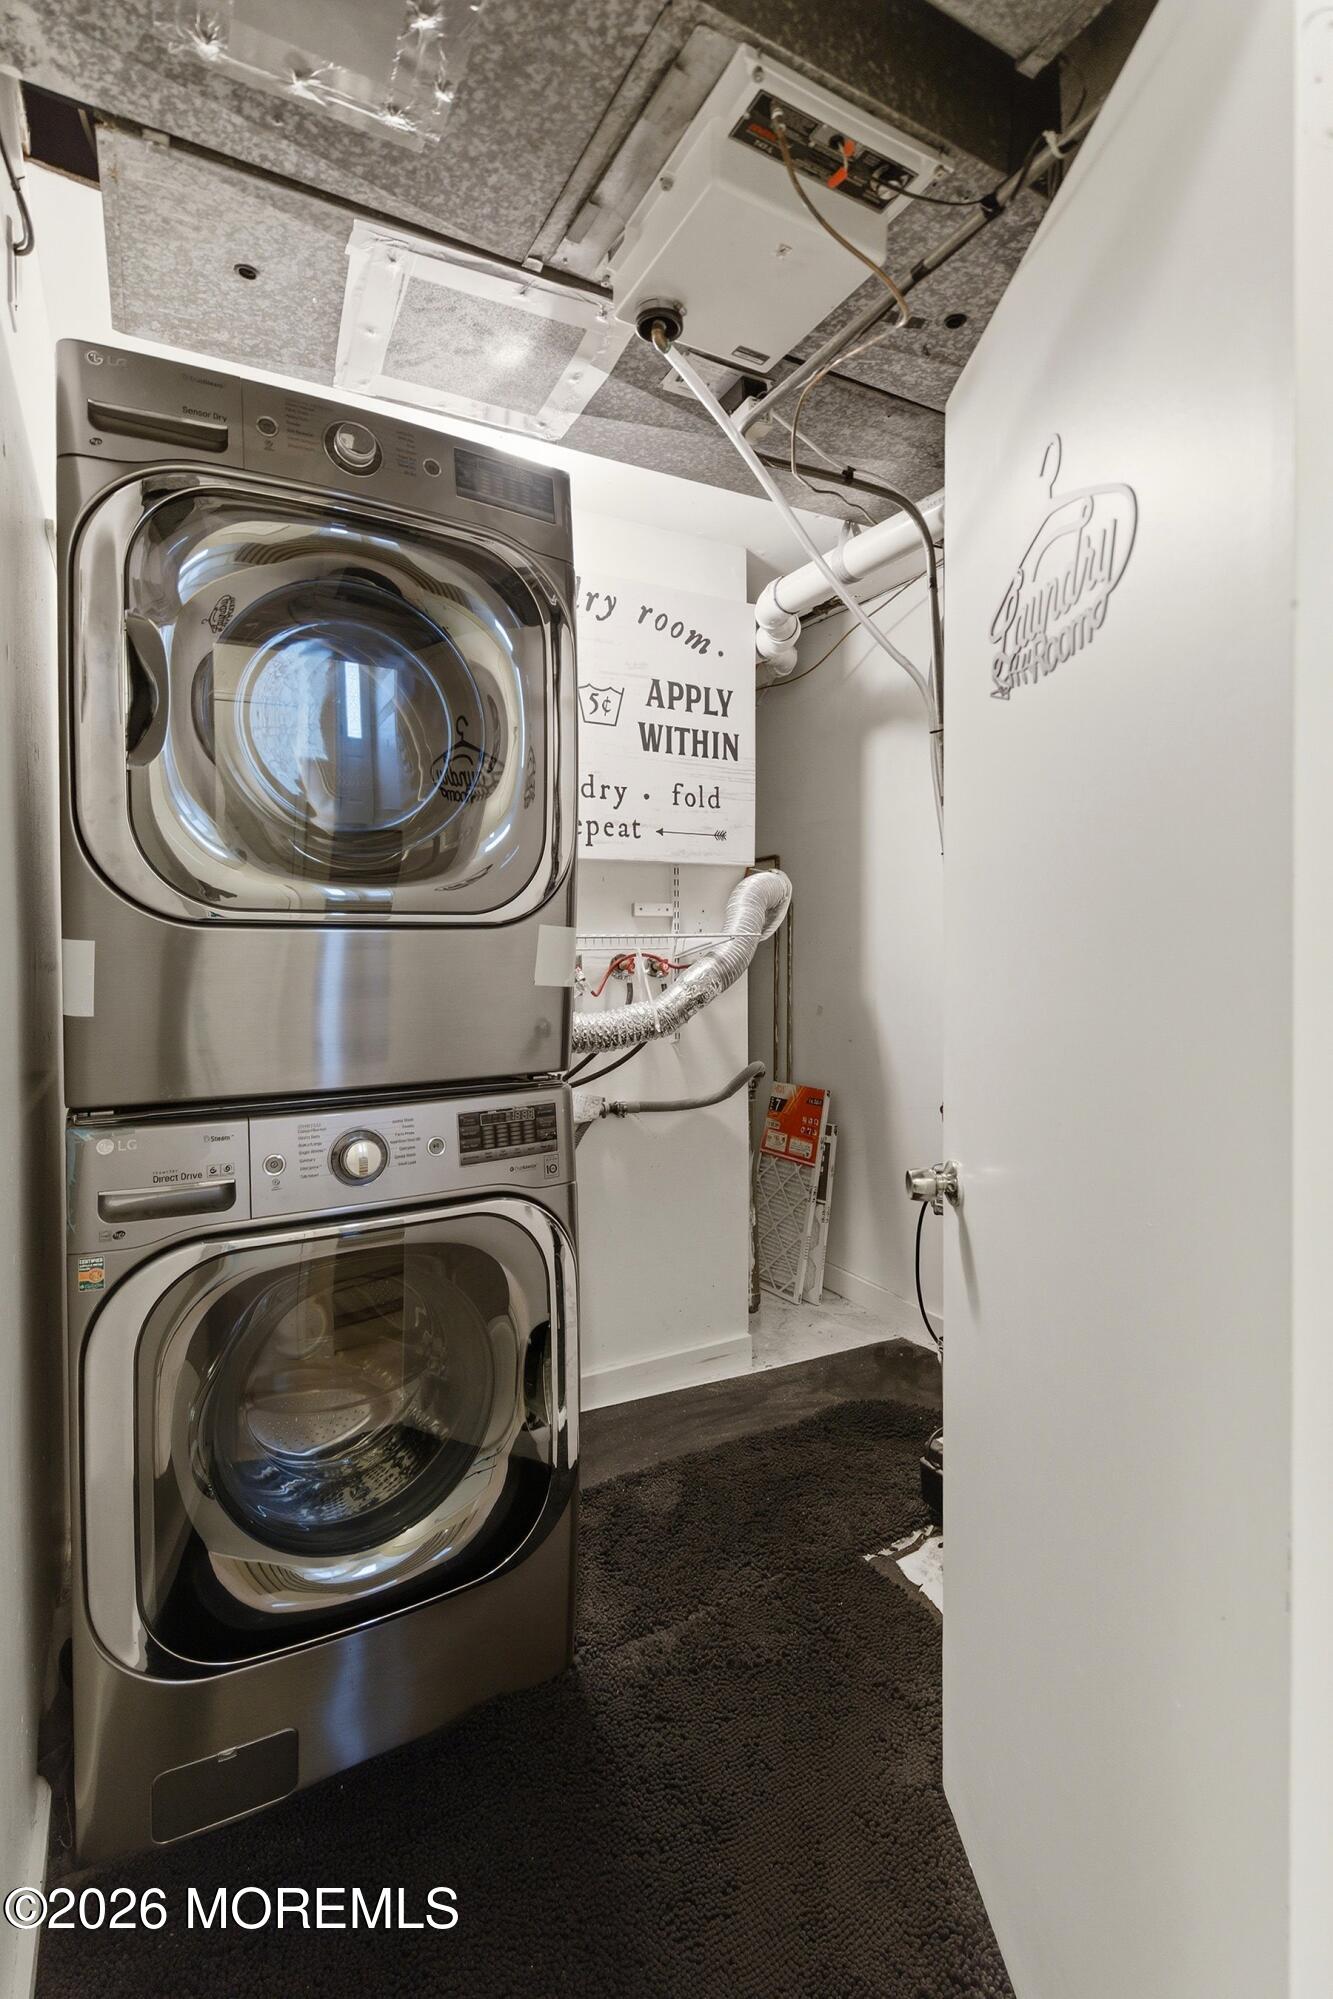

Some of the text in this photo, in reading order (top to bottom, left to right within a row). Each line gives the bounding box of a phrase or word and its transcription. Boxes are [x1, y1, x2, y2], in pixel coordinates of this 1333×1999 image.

[182, 405, 228, 423] Sensor Dry
[588, 692, 612, 716] 5¢
[645, 678, 734, 718] APPLY
[637, 721, 740, 762] WITHIN
[580, 773, 721, 810] dry fold
[117, 1139, 138, 1152] LG
[152, 1174, 179, 1184] Direct
[180, 1171, 203, 1181] Drive
